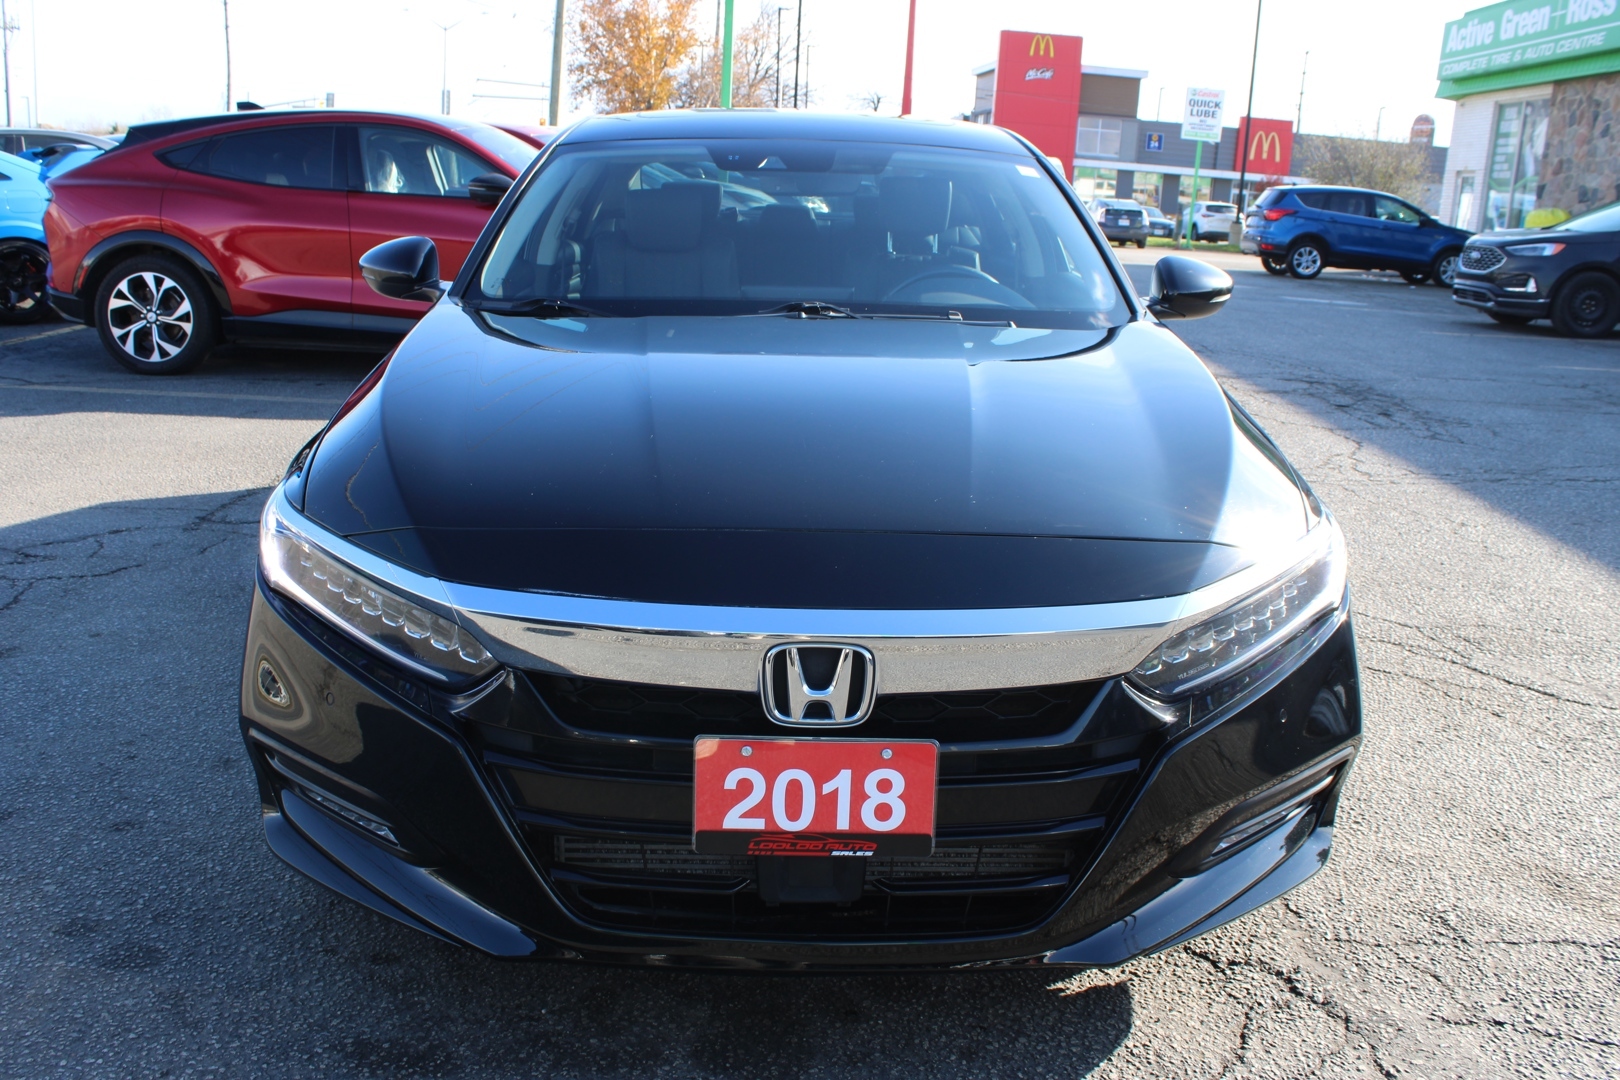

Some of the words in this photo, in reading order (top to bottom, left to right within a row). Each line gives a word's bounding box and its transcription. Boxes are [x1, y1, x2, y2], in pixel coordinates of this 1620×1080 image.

[1445, 18, 1495, 53] Active
[1500, 5, 1551, 41] Green
[1442, 56, 1489, 75] COMPLETE
[1490, 51, 1512, 66] TIRE
[1512, 49, 1522, 62] &
[1523, 42, 1555, 59] AUTO
[1556, 31, 1607, 53] CENTRE
[1188, 98, 1222, 110] QUICK
[1190, 108, 1218, 119] LUBE
[722, 767, 906, 832] 2018
[825, 843, 877, 851] AUTO
